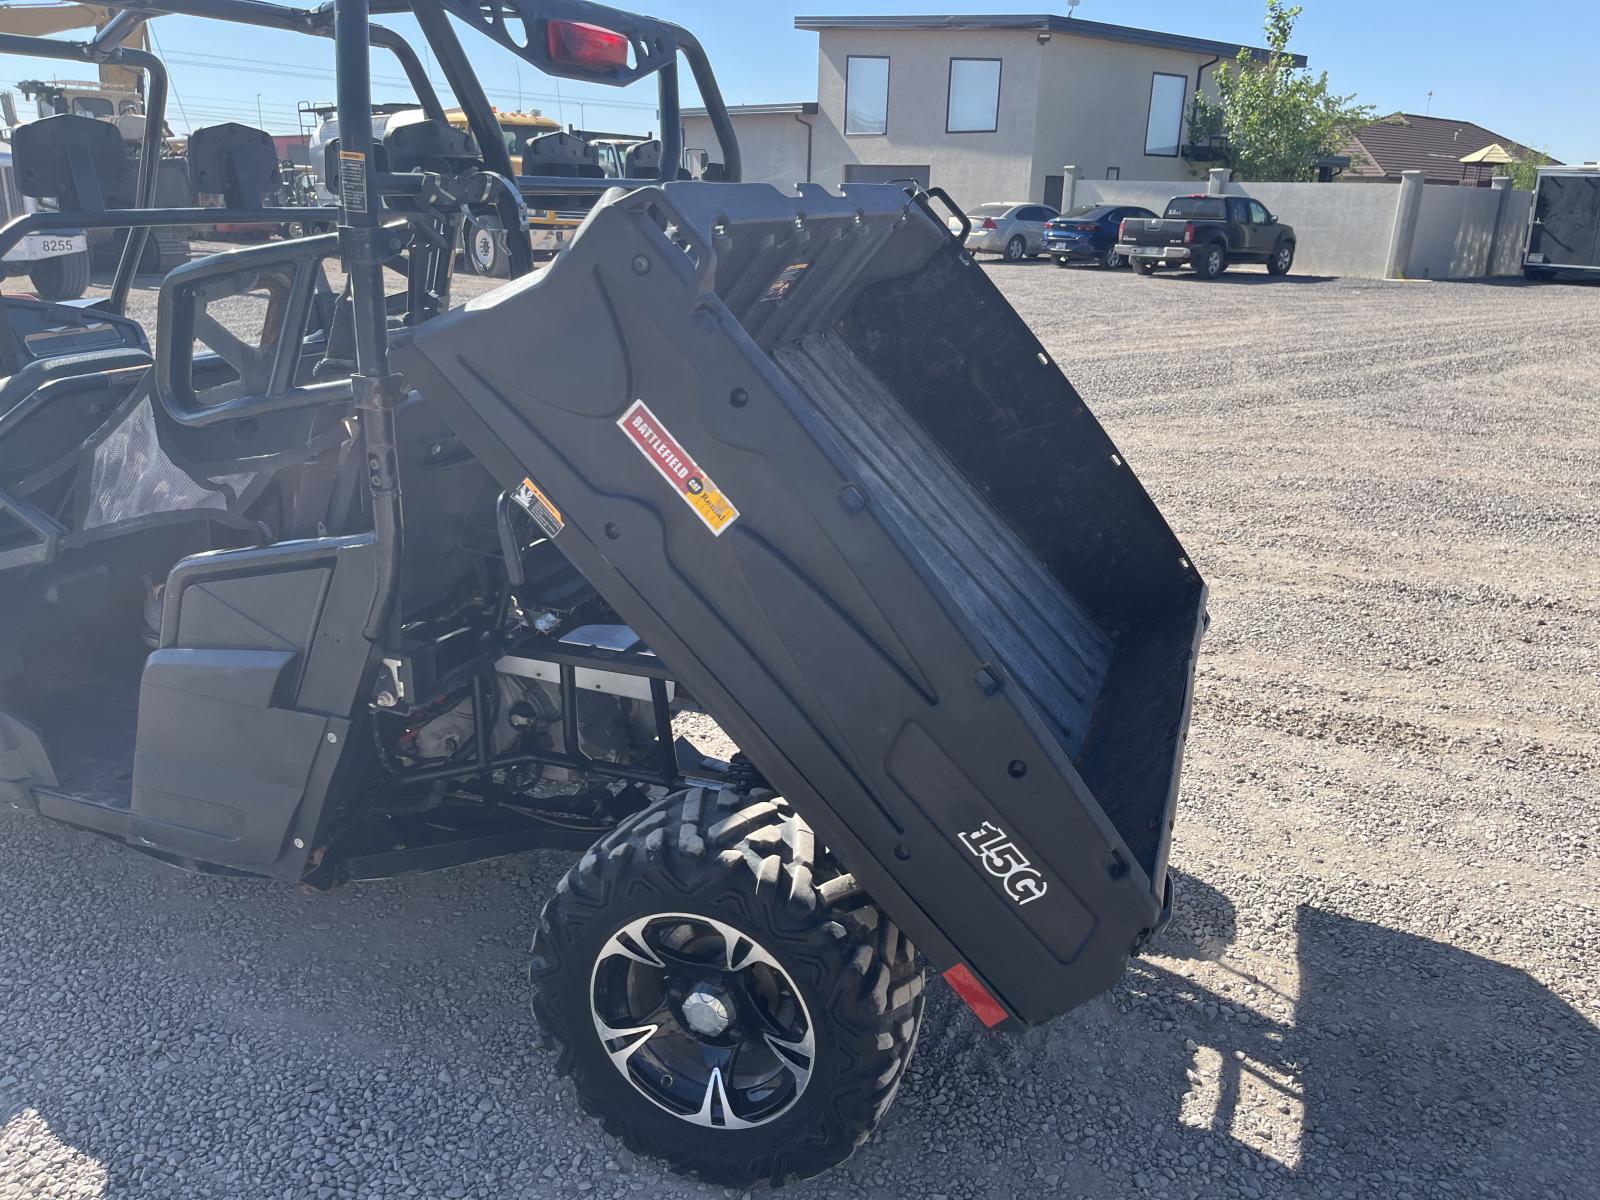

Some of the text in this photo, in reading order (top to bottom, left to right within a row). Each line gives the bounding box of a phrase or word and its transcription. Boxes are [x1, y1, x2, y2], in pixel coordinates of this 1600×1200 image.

[42, 240, 73, 252] 8255
[632, 416, 690, 479] BATTLEFIELD
[688, 479, 702, 492] CAT
